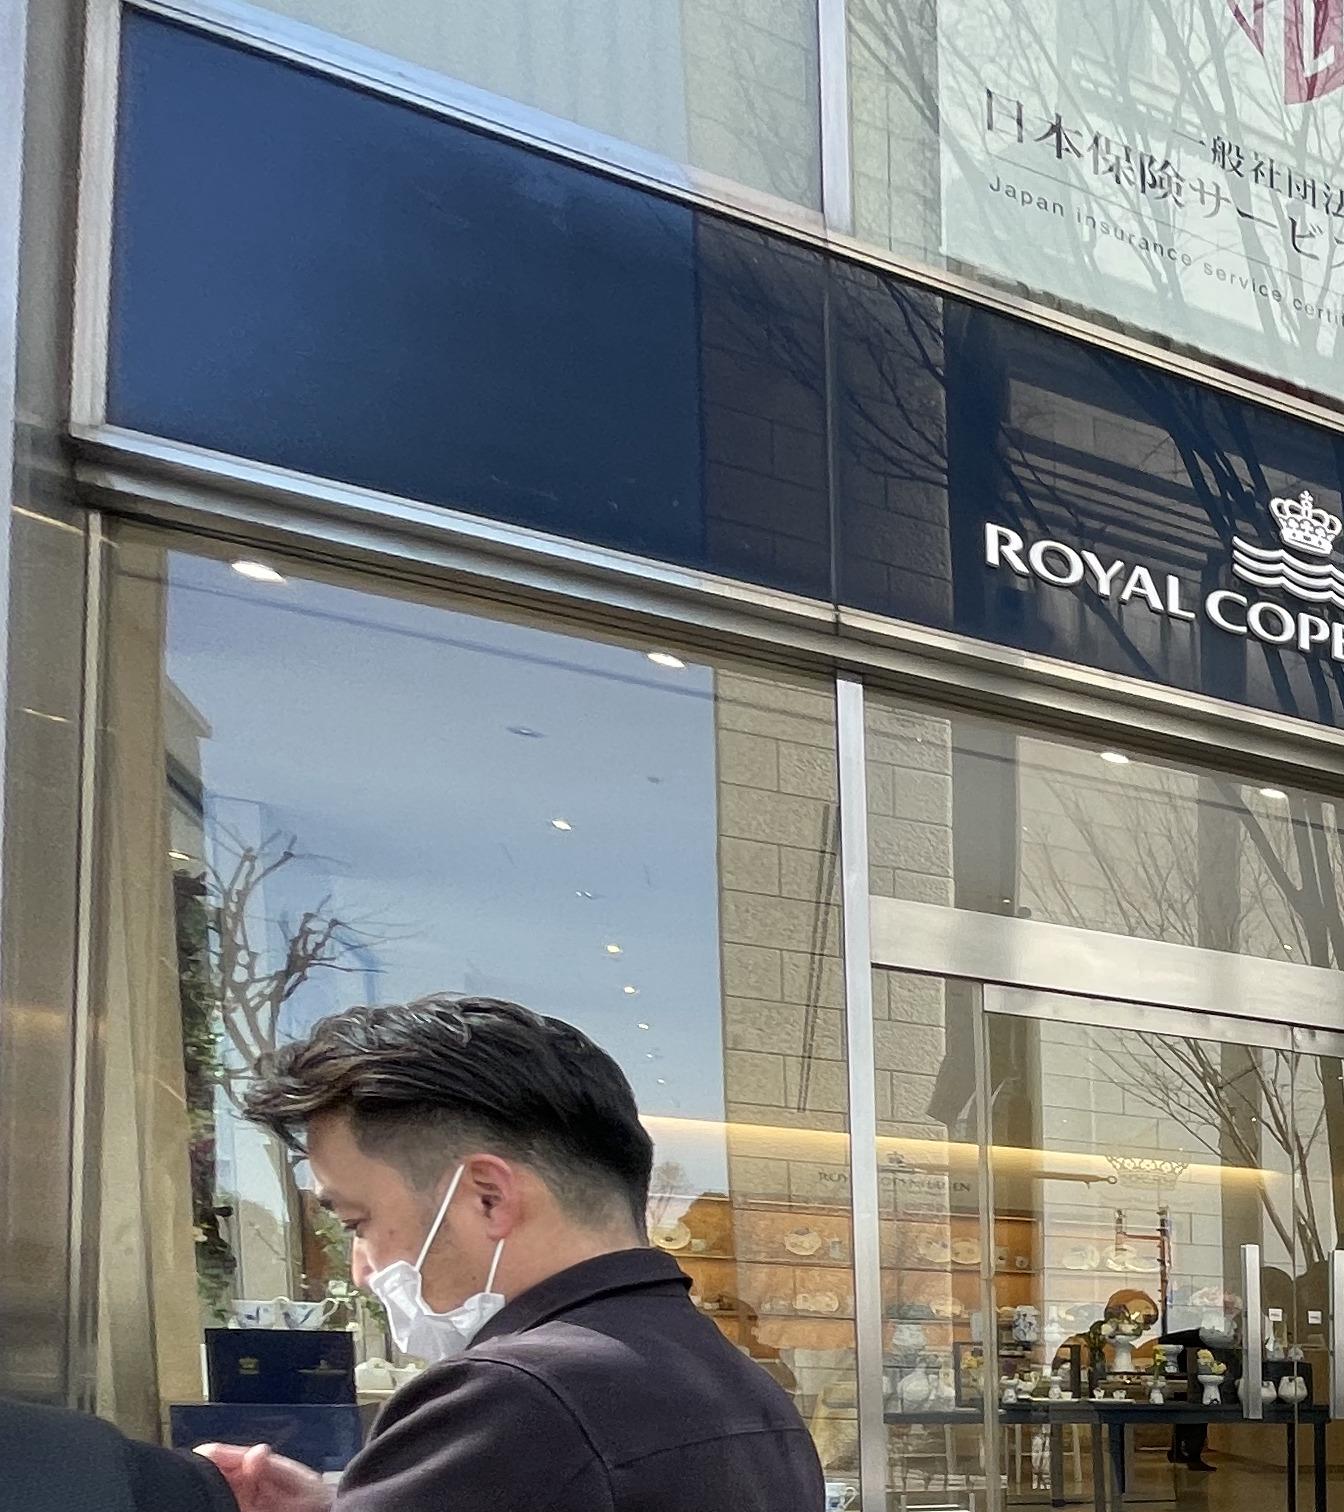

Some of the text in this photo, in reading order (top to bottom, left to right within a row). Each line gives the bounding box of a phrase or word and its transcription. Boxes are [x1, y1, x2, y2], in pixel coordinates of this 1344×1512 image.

[989, 176, 1065, 217] Japan
[1077, 207, 1192, 266] insurance
[1203, 262, 1282, 302] service
[984, 522, 1195, 621] ROYAL
